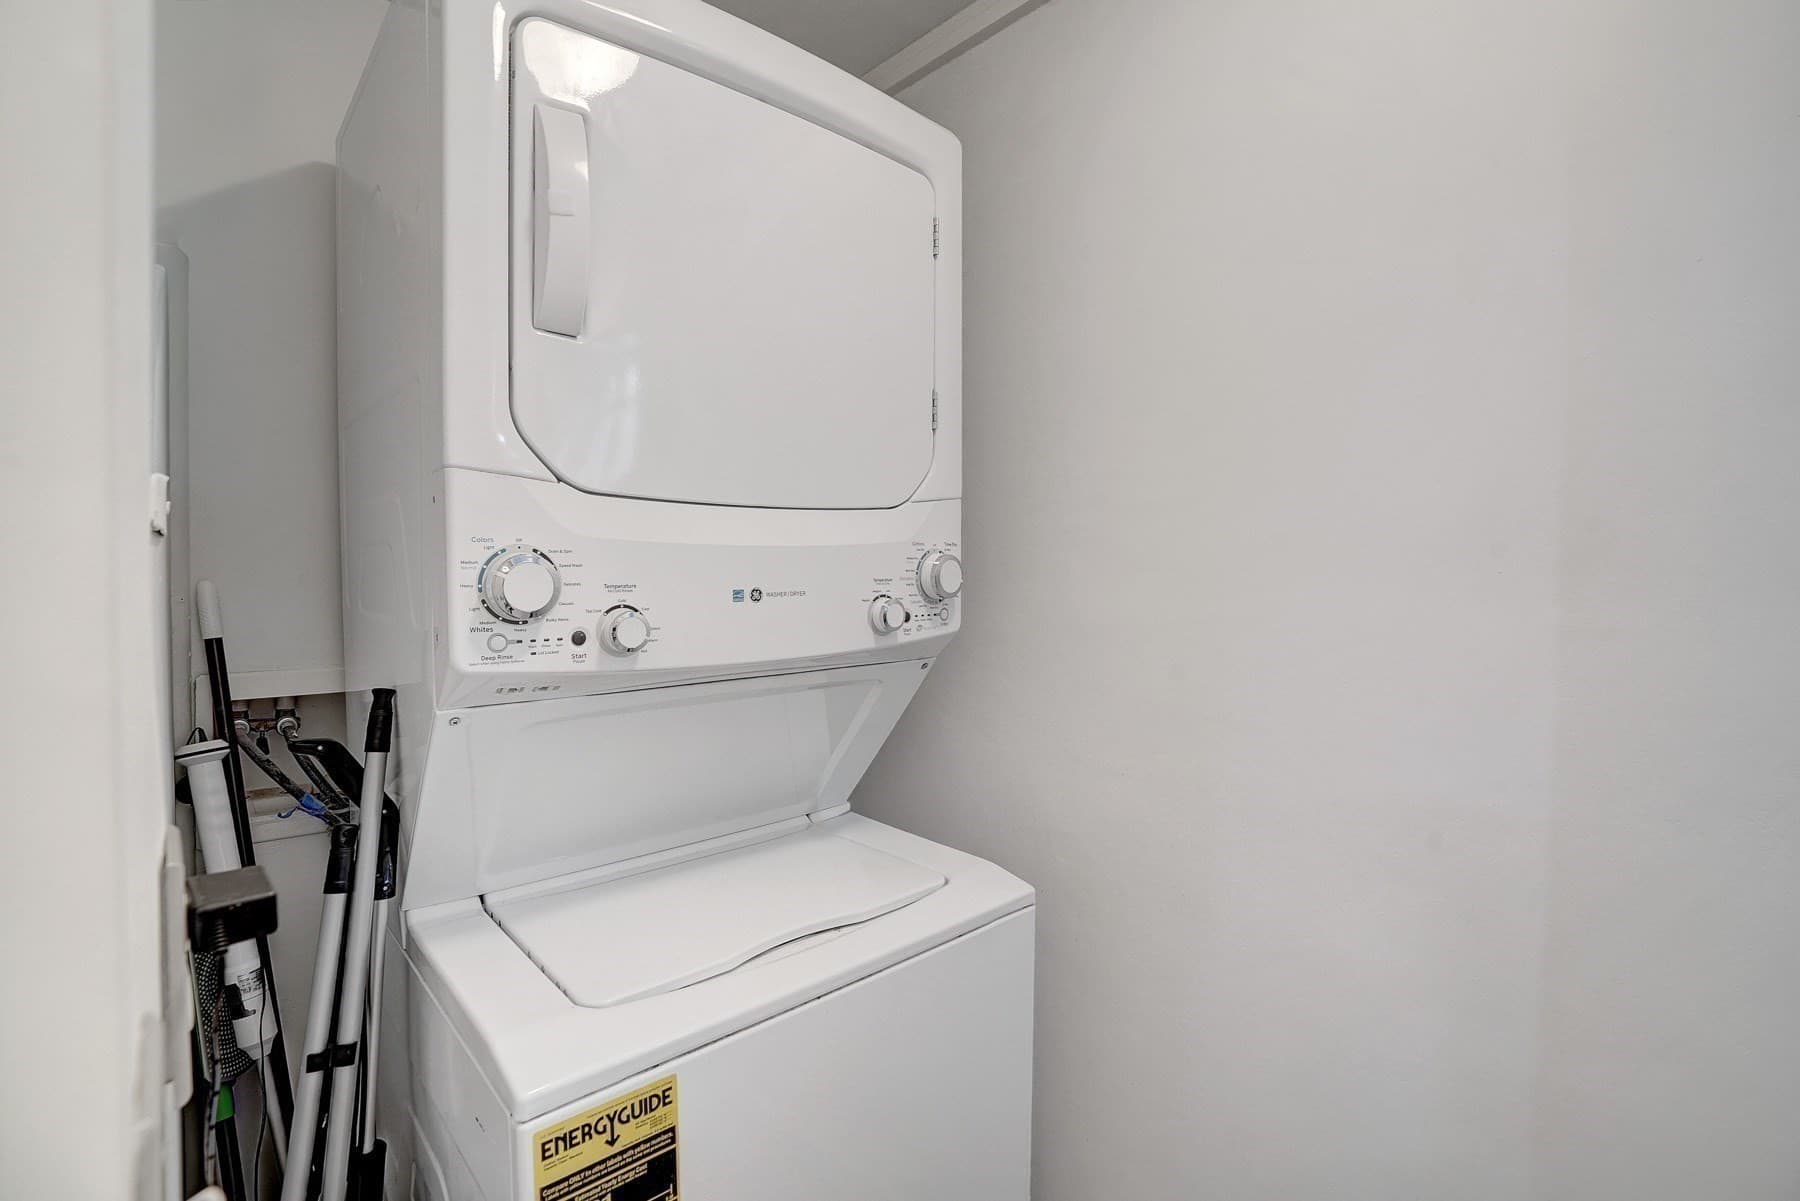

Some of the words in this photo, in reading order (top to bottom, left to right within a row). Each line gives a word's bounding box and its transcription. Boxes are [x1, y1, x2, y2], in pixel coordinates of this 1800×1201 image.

[541, 1086, 673, 1162] ENERGYGUIDE
[542, 1180, 568, 1197] Compare
[568, 1171, 584, 1184] ONLY
[591, 1161, 606, 1174] other
[606, 1154, 621, 1166] labels
[622, 1148, 634, 1158] with
[634, 1141, 650, 1154] yellow
[601, 1177, 616, 1189] Yearly
[617, 1168, 635, 1182] Energy
[636, 1162, 647, 1172] Cost
